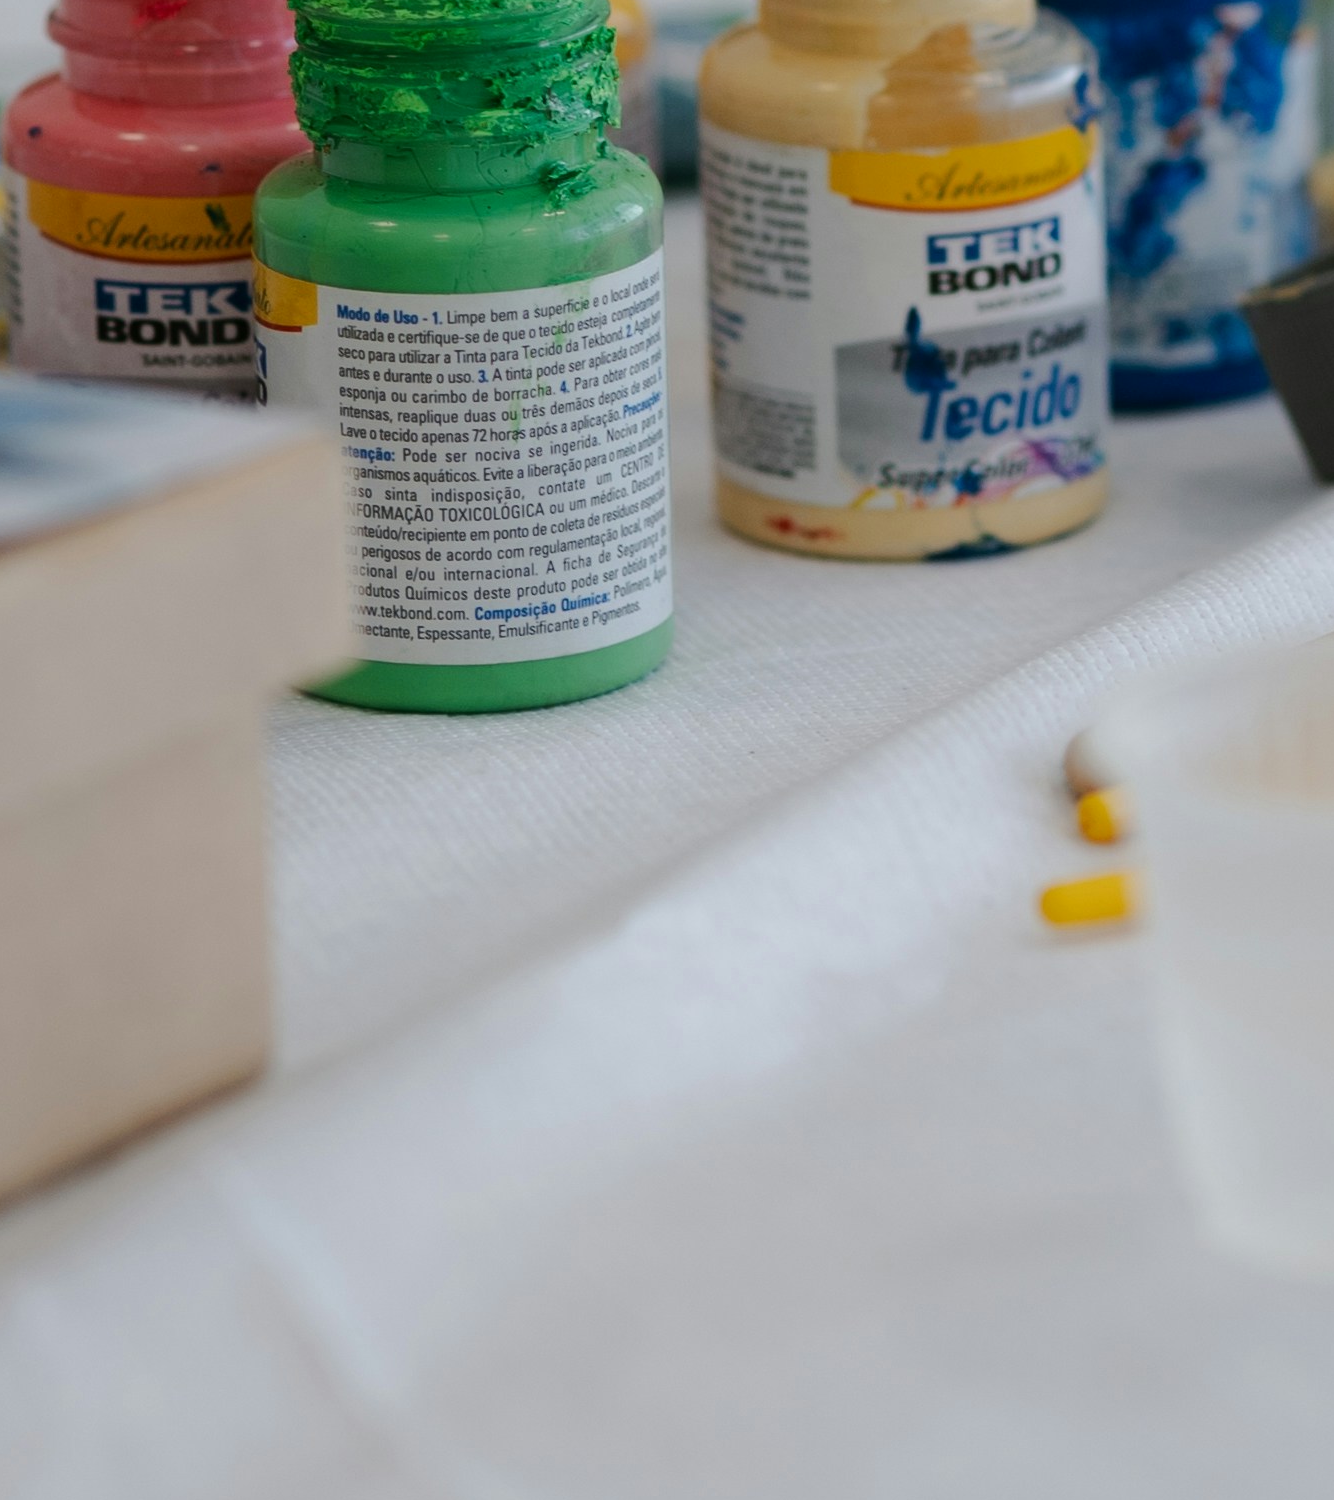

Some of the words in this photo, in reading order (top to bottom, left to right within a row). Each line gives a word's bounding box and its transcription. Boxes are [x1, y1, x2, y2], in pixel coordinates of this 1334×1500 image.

[927, 217, 1060, 264] TEK
[929, 253, 1062, 296] BOND
[97, 281, 250, 314] TEK
[337, 304, 370, 322] Modo
[374, 309, 389, 323] de
[394, 310, 418, 324] Uso
[432, 312, 442, 324] 1.
[447, 310, 485, 326] Limpe
[490, 310, 517, 322] bem
[523, 310, 529, 319] a
[593, 297, 598, 307] e
[602, 294, 608, 304] o
[611, 283, 630, 301] local
[96, 317, 251, 347] BOND
[338, 325, 384, 342] utilizada
[388, 333, 394, 342] e
[399, 330, 480, 347] certifique-se
[484, 330, 499, 342] de
[502, 328, 525, 343] que
[529, 328, 535, 338] o
[539, 320, 574, 337] tecido
[577, 312, 607, 331] esteja
[338, 346, 365, 360] seco
[368, 351, 395, 364] para
[399, 350, 440, 363] utilizar
[444, 354, 451, 363] a
[454, 350, 486, 363] Tinta
[490, 350, 519, 365] para
[523, 343, 562, 359] Tecido
[566, 339, 579, 352] da
[339, 366, 370, 380] antes
[373, 371, 380, 381] e
[384, 369, 432, 384] durante
[436, 374, 444, 383] o
[448, 373, 474, 383] uso.
[493, 368, 502, 381] A
[506, 366, 532, 380] tinta
[536, 362, 565, 379] pode
[569, 358, 585, 372] ser
[589, 346, 627, 372] aplicada
[340, 386, 385, 403] esponja
[392, 392, 406, 403] ou
[413, 390, 467, 403] carimbo
[472, 390, 488, 402] de
[494, 384, 555, 401] borracha.
[574, 375, 599, 391] Para
[603, 365, 627, 384] obter
[340, 403, 393, 423] intensas,
[398, 410, 458, 426] reaplique
[464, 410, 495, 422] duas
[502, 411, 517, 421] ou
[522, 405, 545, 419] três
[550, 396, 594, 415] demãos
[599, 384, 628, 405] depois
[921, 363, 1081, 443] Tecido
[340, 423, 366, 438] Lave
[370, 430, 377, 440] o
[380, 429, 418, 442] tecido
[422, 431, 469, 445] apenas
[472, 429, 487, 442] 72
[490, 428, 526, 441] horas
[530, 421, 557, 440] após
[561, 423, 567, 433] a
[403, 448, 437, 462] Pode
[446, 451, 467, 462] ser
[475, 446, 520, 461] nociva
[529, 447, 542, 458] se
[550, 434, 601, 455] ingerida.
[607, 423, 638, 443] Nociva
[413, 469, 479, 485] aquáticos.
[483, 467, 514, 480] Evite
[517, 469, 524, 478] a
[528, 459, 582, 478] liberação
[584, 454, 606, 471] para
[609, 451, 614, 461] o
[385, 487, 417, 501] sinta
[431, 487, 525, 504] indisposição,
[539, 478, 585, 496] contate
[597, 472, 612, 485] um
[346, 503, 433, 525] NFORMAÇÃO
[439, 500, 544, 522] TOXICOLÓGICA
[550, 504, 564, 514] ou
[570, 499, 586, 511] um
[591, 485, 628, 506] médico.
[470, 530, 489, 541] em
[493, 526, 528, 543] ponto
[533, 523, 547, 537] de
[551, 515, 584, 534] coleta
[588, 513, 600, 527] de
[362, 545, 421, 562] perigosos
[426, 548, 441, 561] de
[447, 547, 492, 561] acordo
[497, 548, 525, 560] com
[529, 529, 618, 558] regulamentação
[405, 567, 435, 581] e/ou
[444, 563, 538, 580] internacional.
[546, 560, 555, 574] A
[564, 556, 591, 571] ficha
[599, 550, 611, 564] de
[405, 586, 468, 600] Químicos
[474, 586, 511, 600] deste
[517, 582, 566, 600] produto
[572, 573, 598, 592] pode
[603, 569, 618, 583] ser
[474, 601, 556, 622] Composição
[417, 625, 495, 643] Espessante,
[498, 620, 579, 638] Emulsificante
[583, 616, 588, 627] e
